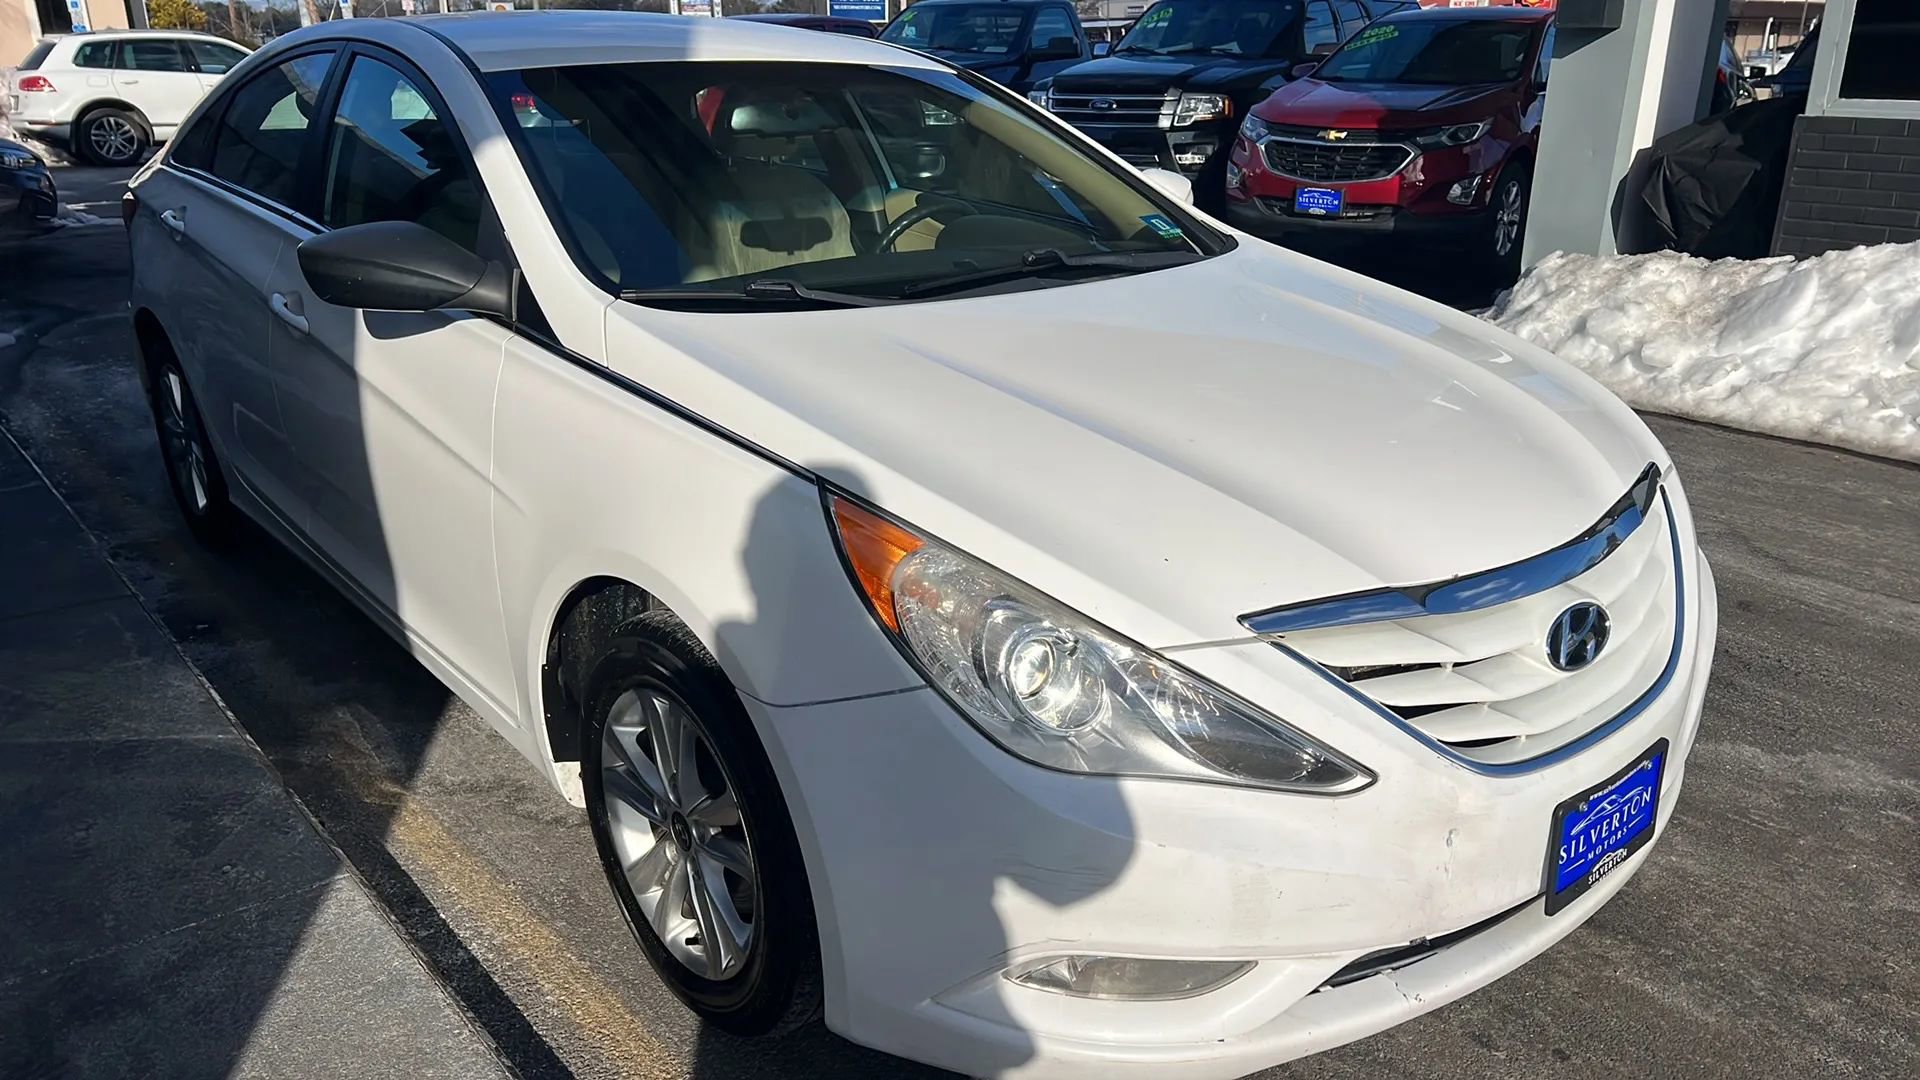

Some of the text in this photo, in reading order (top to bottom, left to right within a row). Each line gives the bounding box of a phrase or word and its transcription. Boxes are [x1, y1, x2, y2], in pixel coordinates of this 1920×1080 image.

[1298, 197, 1339, 206] SILVERTON
[1558, 786, 1652, 865] SILVERTON
[1587, 825, 1628, 861] MOTORS
[1588, 848, 1628, 885] SILVERTON
